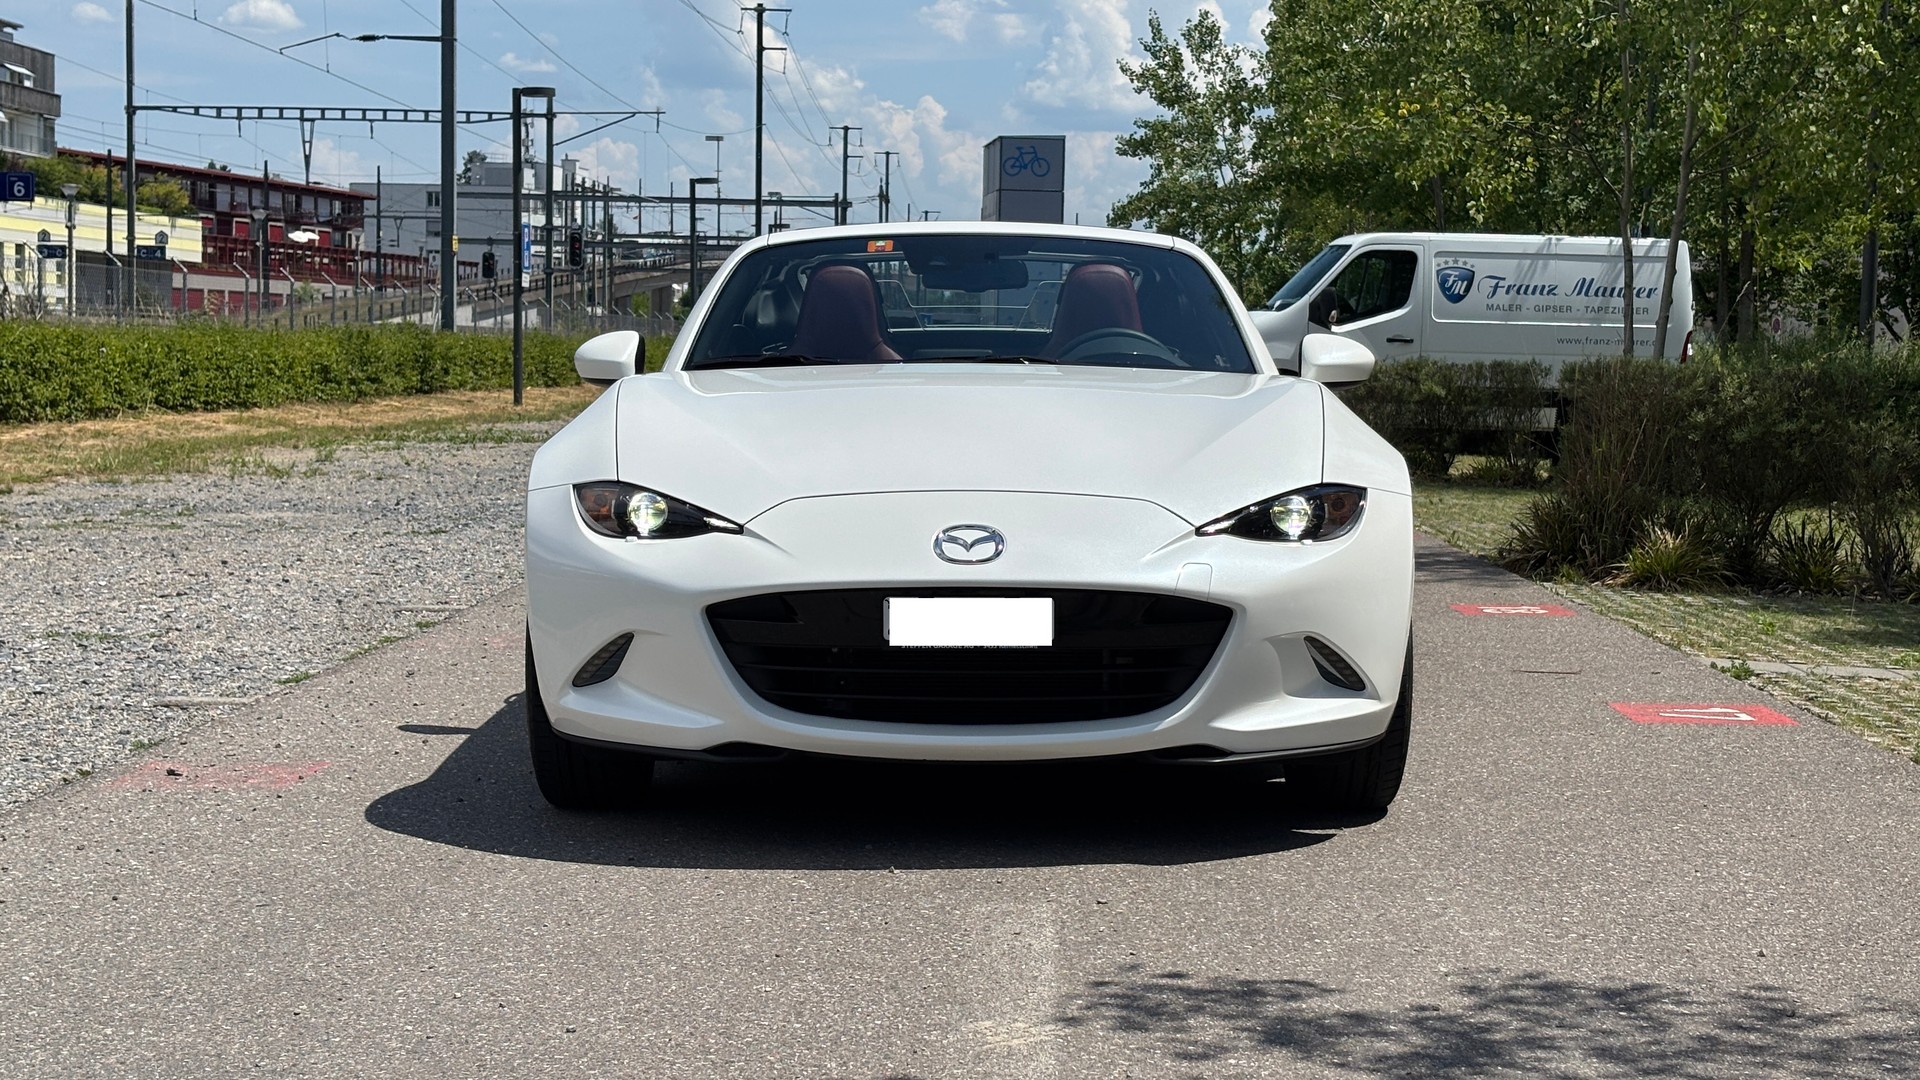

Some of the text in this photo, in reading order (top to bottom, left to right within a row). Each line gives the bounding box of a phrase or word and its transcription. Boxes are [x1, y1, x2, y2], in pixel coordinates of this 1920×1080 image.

[13, 181, 25, 197] 6
[1478, 274, 1659, 300] Franz Mauer
[1485, 303, 1522, 313] MALER
[1533, 304, 1573, 314] GIPSER
[1658, 707, 1756, 721] 17
